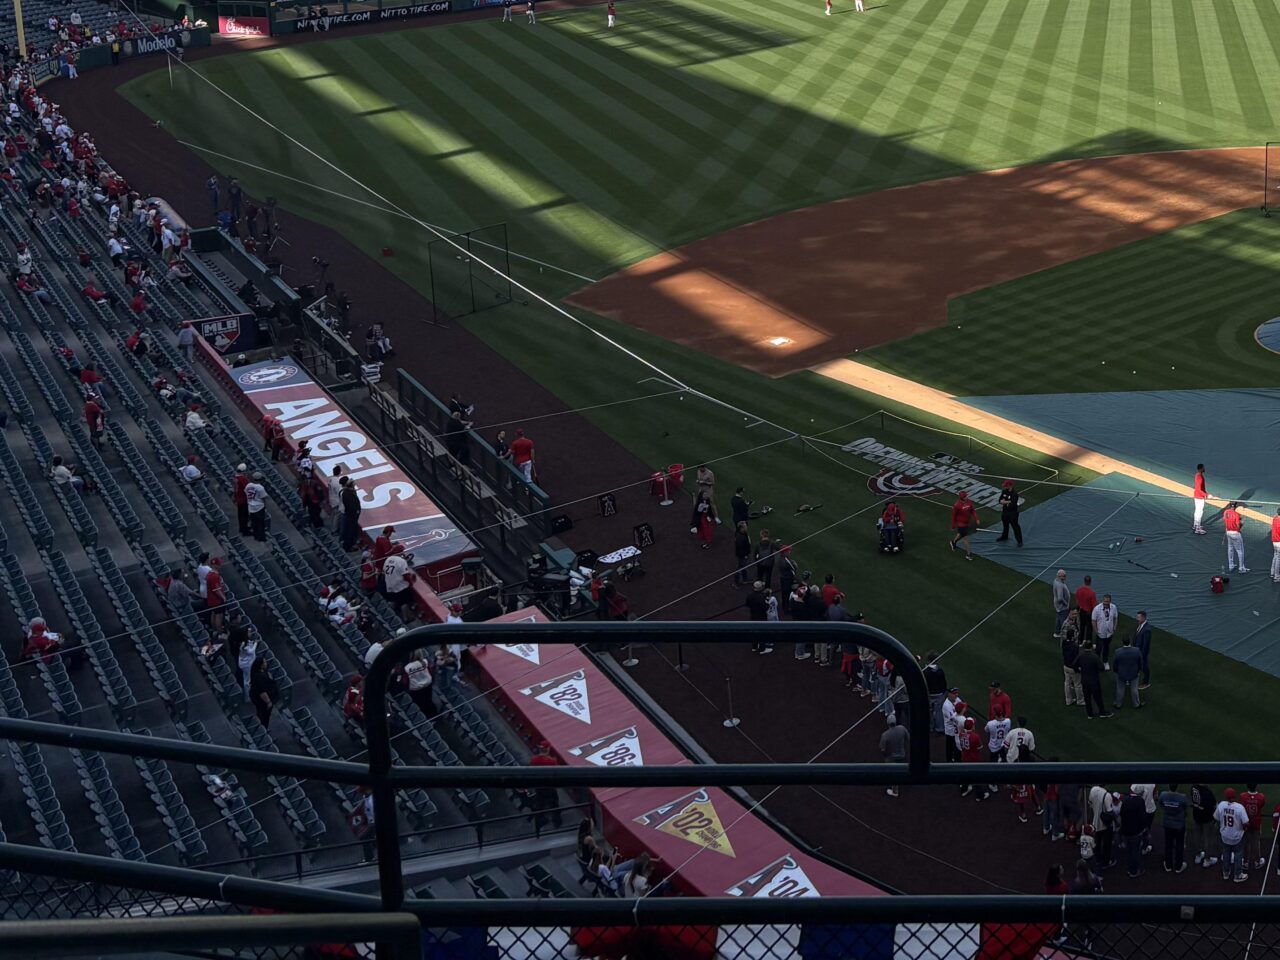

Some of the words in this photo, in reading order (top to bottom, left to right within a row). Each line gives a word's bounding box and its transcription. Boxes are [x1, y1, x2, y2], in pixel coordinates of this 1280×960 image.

[380, 6, 407, 19] NITTO
[409, 2, 449, 15] TIRE.COM
[137, 34, 175, 54] Modelo
[204, 319, 237, 334] MLB
[264, 397, 416, 510] ANGELS
[918, 465, 1025, 512] WEEKEN
[385, 565, 395, 575] 27
[549, 684, 583, 706] '82
[672, 807, 713, 837] '02
